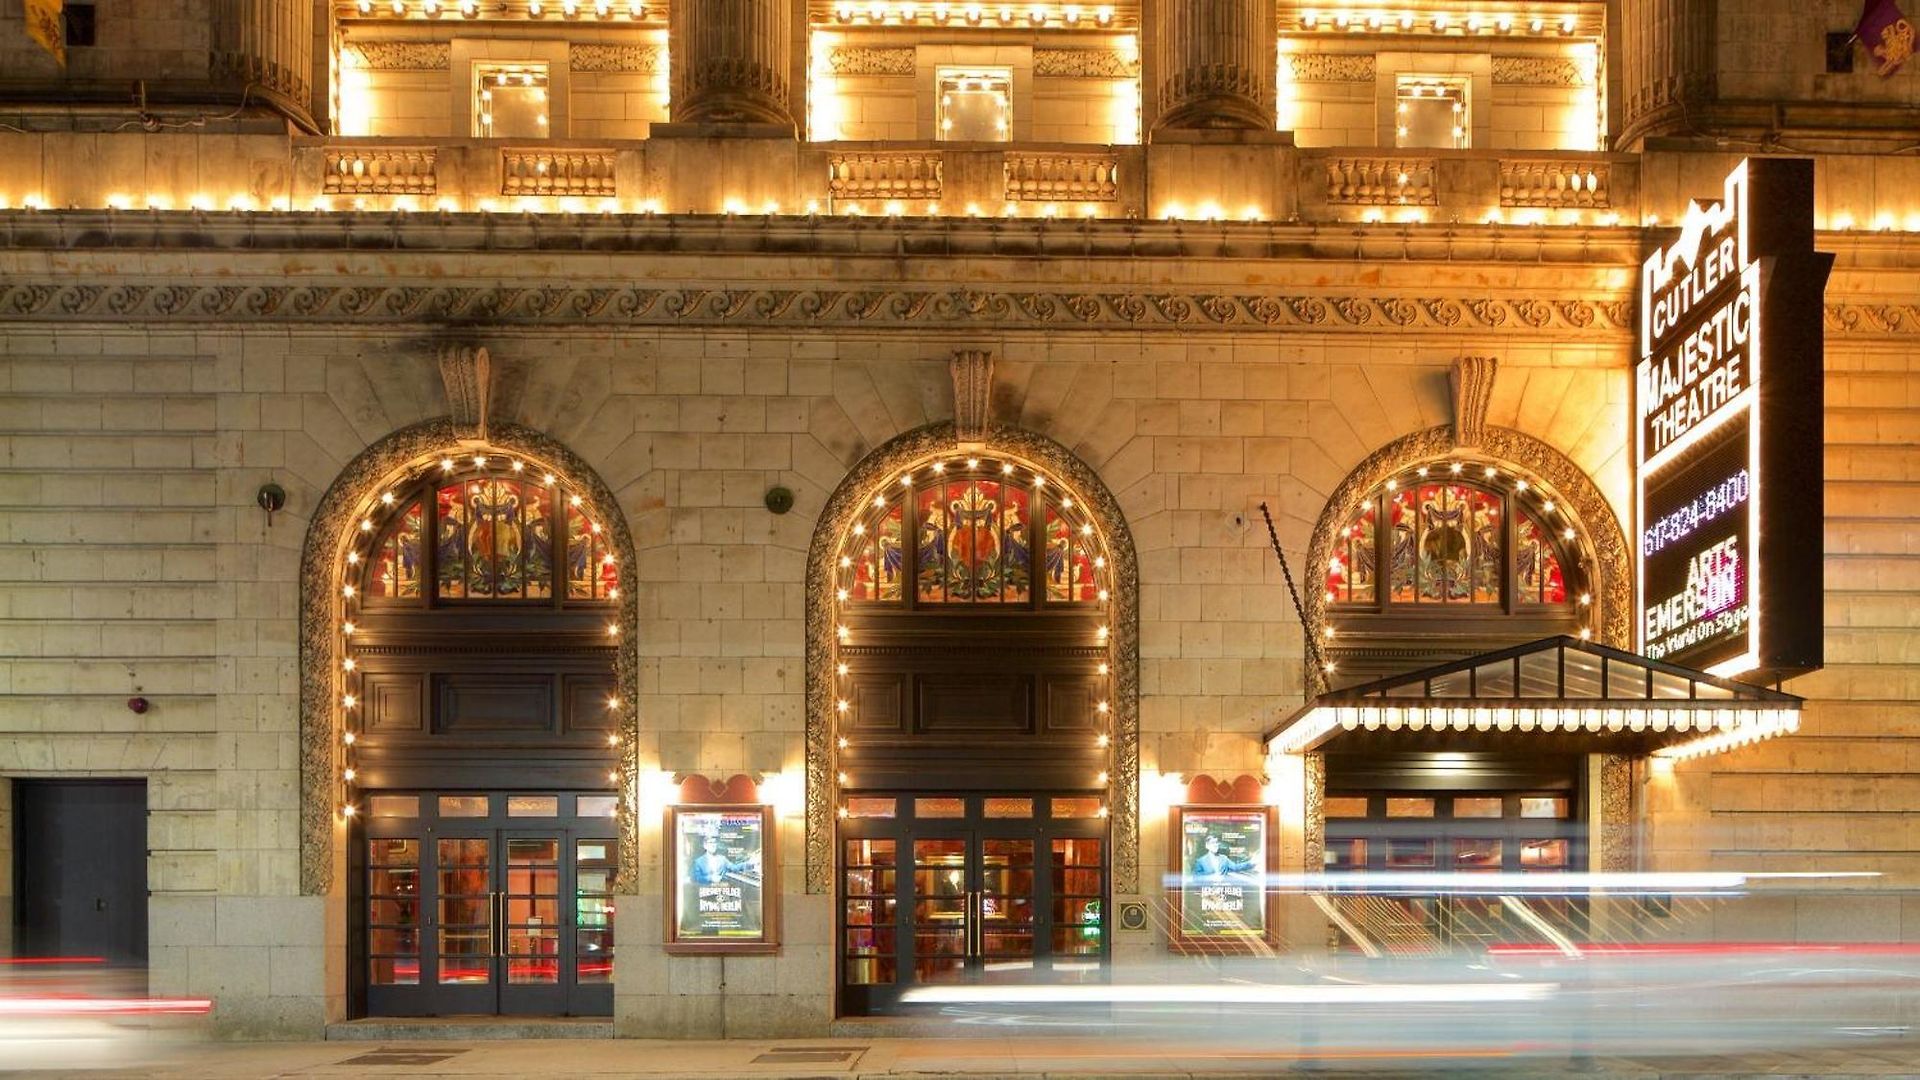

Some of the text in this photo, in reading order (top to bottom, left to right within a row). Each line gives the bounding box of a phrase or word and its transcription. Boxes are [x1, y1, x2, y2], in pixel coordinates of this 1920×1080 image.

[1653, 236, 1735, 339] CUTLER
[1640, 290, 1751, 418] MAJESTIC
[1650, 353, 1740, 452] THEATRE
[1644, 468, 1749, 556] 617-824-8400
[1645, 566, 1737, 641] EMERSON
[1686, 534, 1738, 593] ARTS
[1646, 642, 1666, 660] The
[1697, 620, 1715, 639] On
